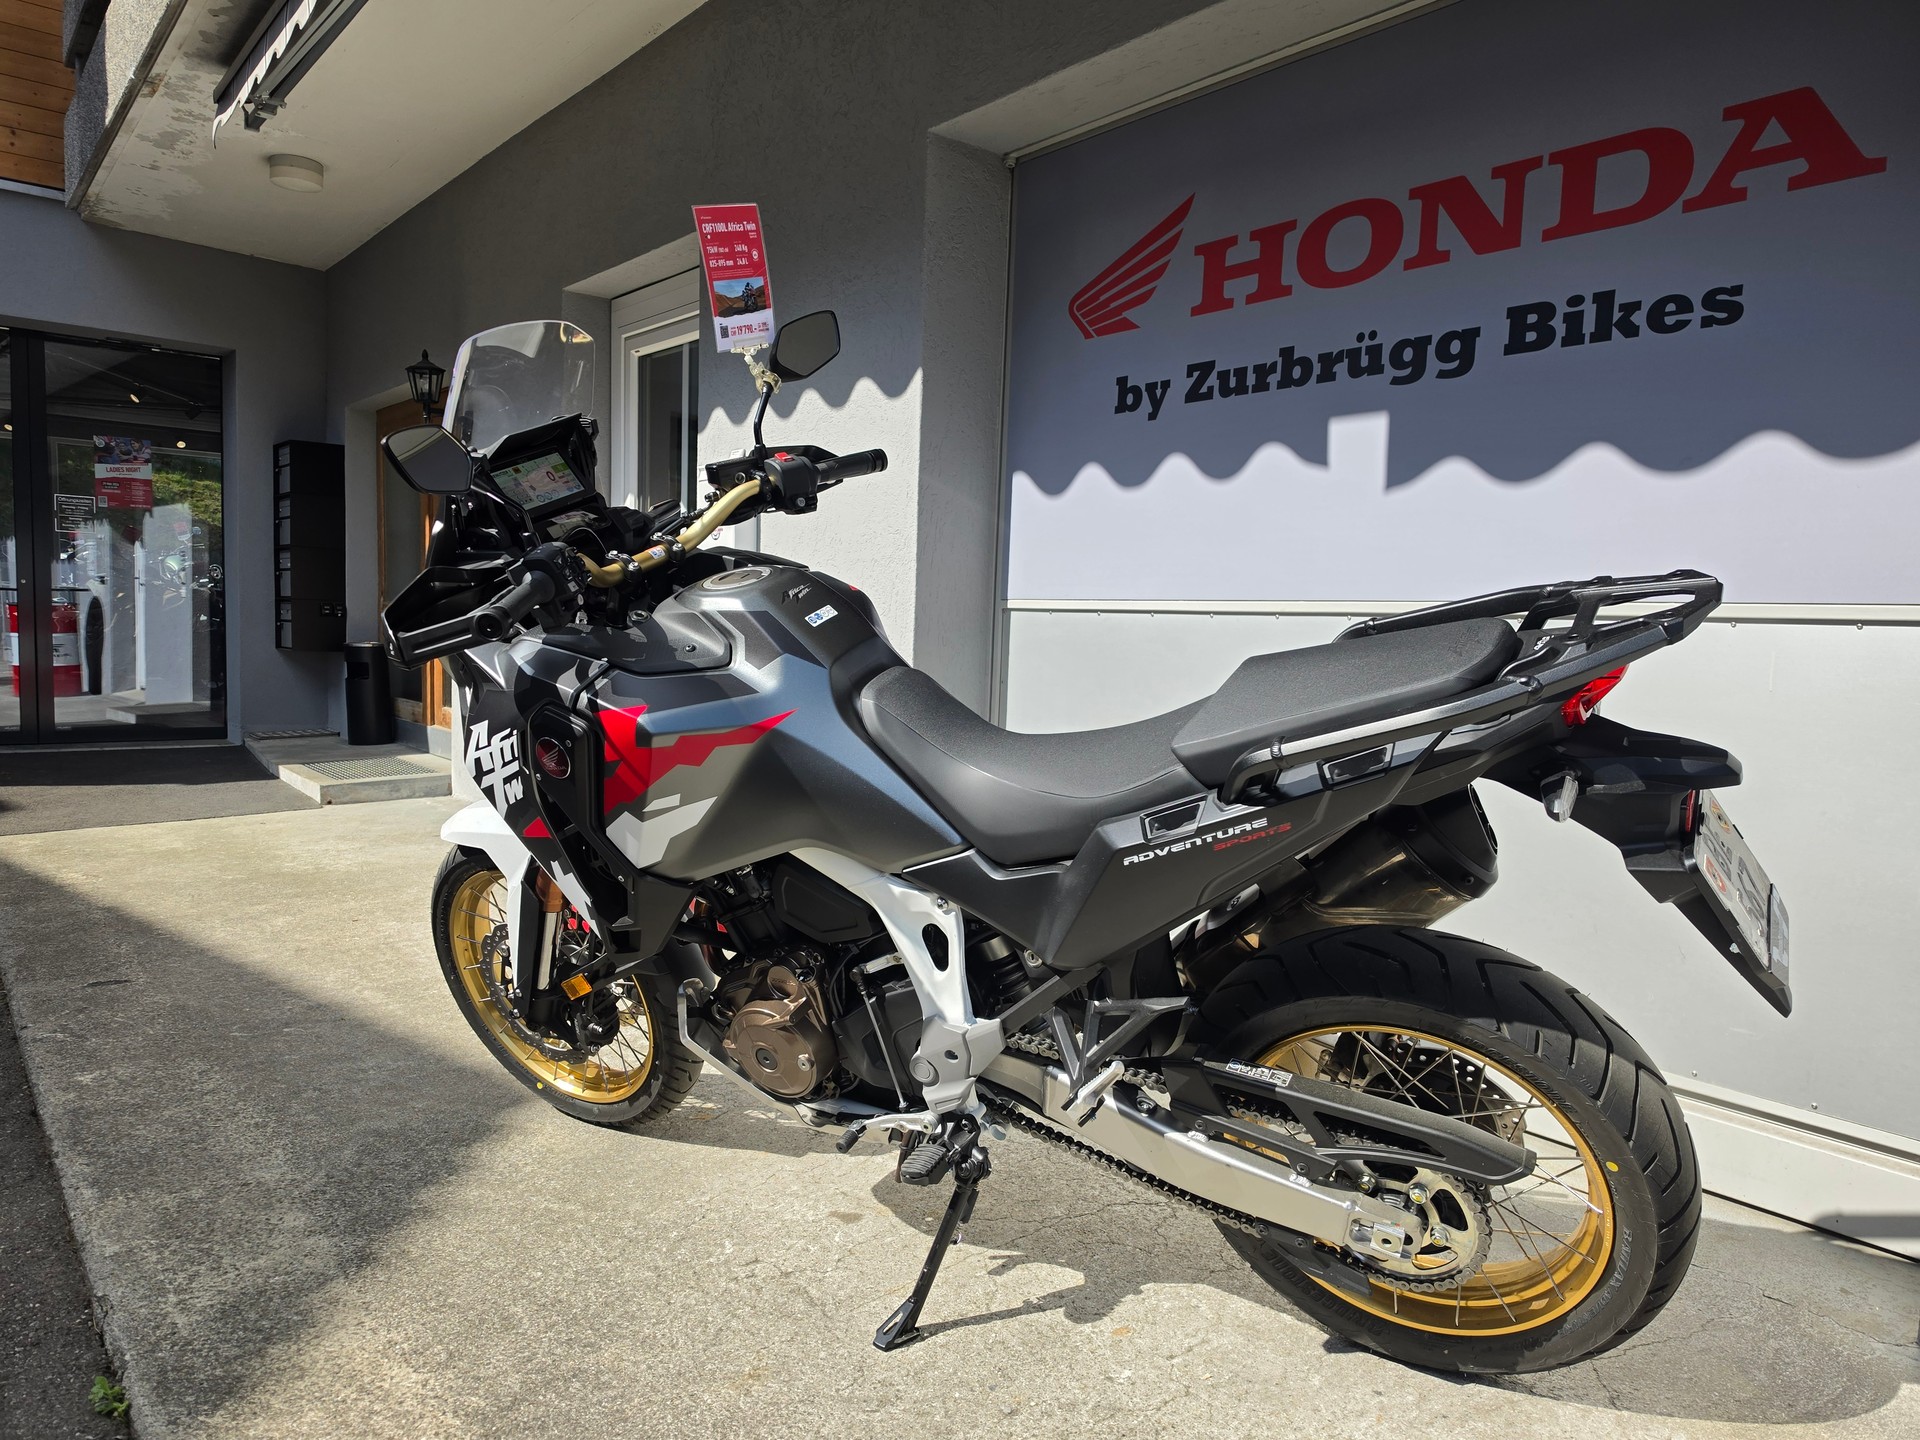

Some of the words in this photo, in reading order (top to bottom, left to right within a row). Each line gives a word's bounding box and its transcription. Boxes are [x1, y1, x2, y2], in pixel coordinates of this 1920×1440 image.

[1190, 86, 1887, 317] HONDA
[702, 222, 727, 234] CRF1100L
[727, 221, 744, 232] Africa
[743, 221, 757, 231] Twin
[1114, 375, 1170, 421] by
[1185, 326, 1481, 404] Zurbrügg
[1503, 283, 1745, 356] Bikes
[1123, 817, 1268, 866] ADVENTURE
[1213, 822, 1292, 851] SPORTS
